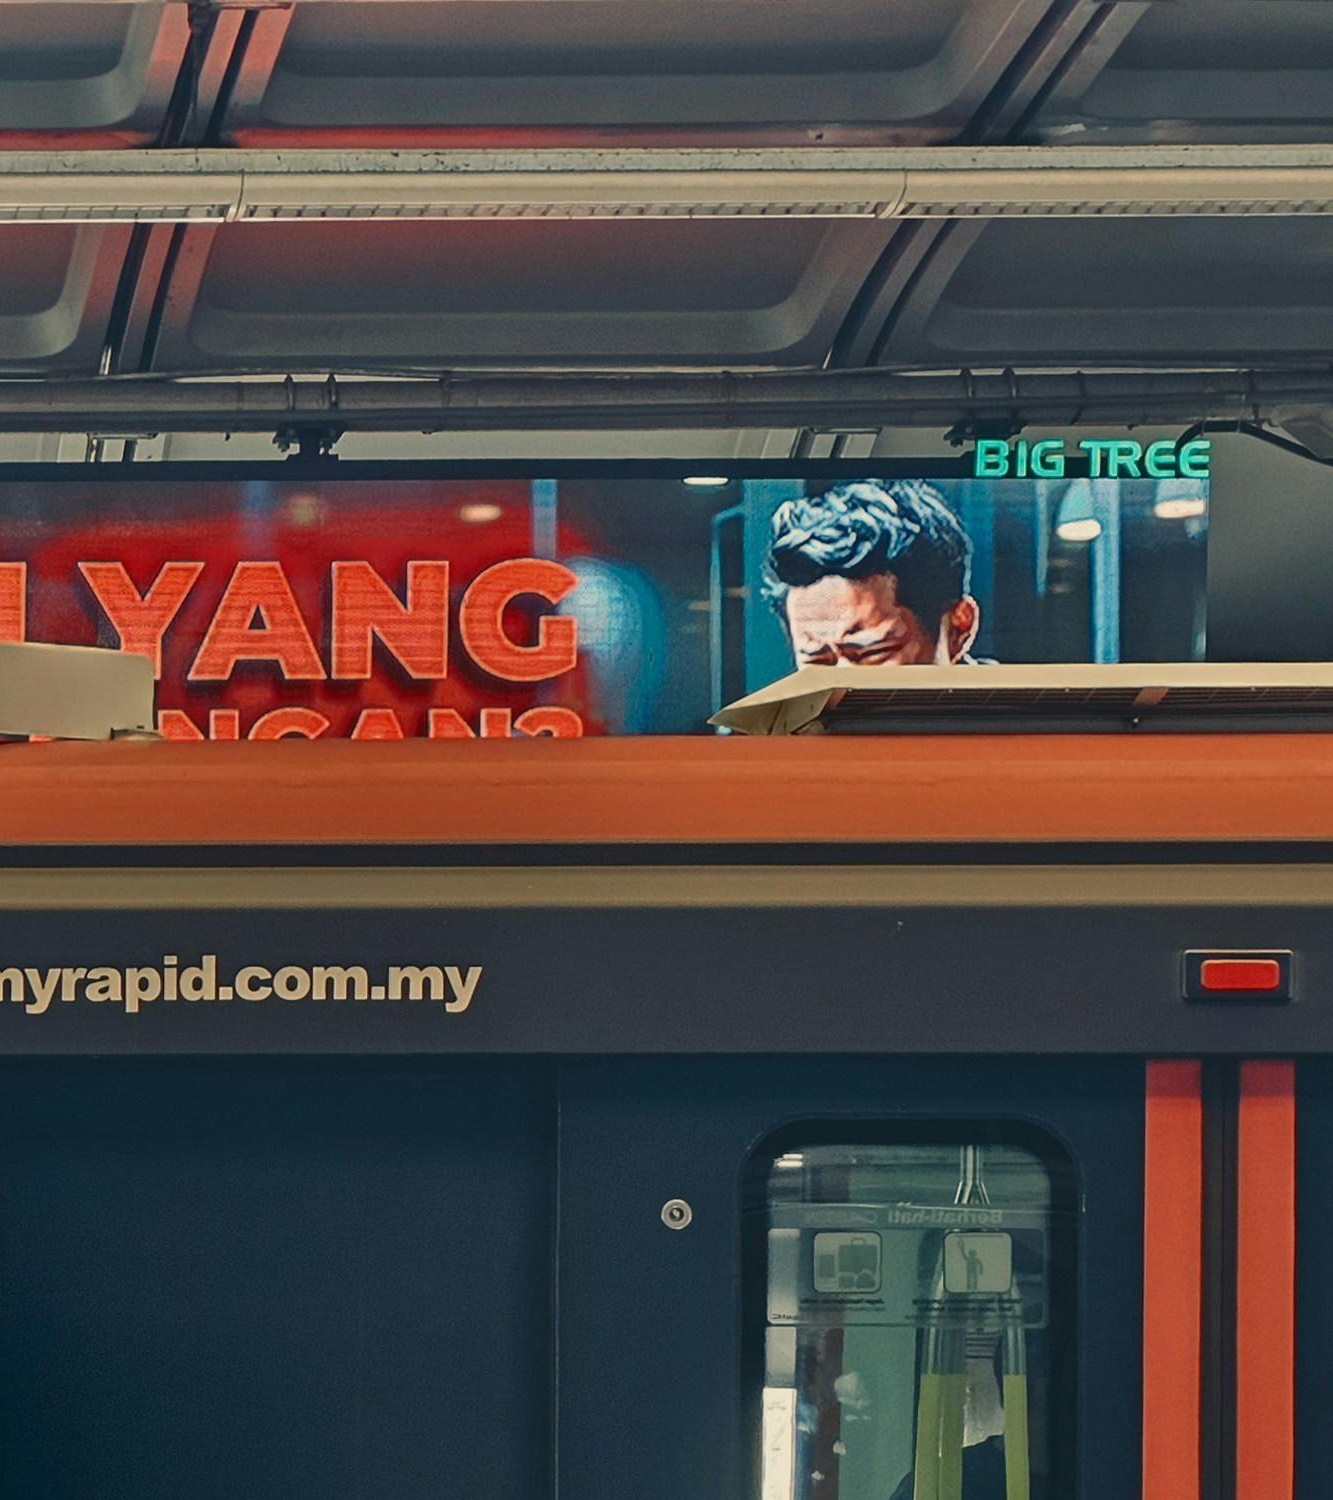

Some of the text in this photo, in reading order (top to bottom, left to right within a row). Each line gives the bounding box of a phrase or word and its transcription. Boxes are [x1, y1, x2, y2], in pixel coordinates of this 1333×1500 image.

[974, 438, 1212, 478] BIG TREE
[77, 557, 580, 682] YANG
